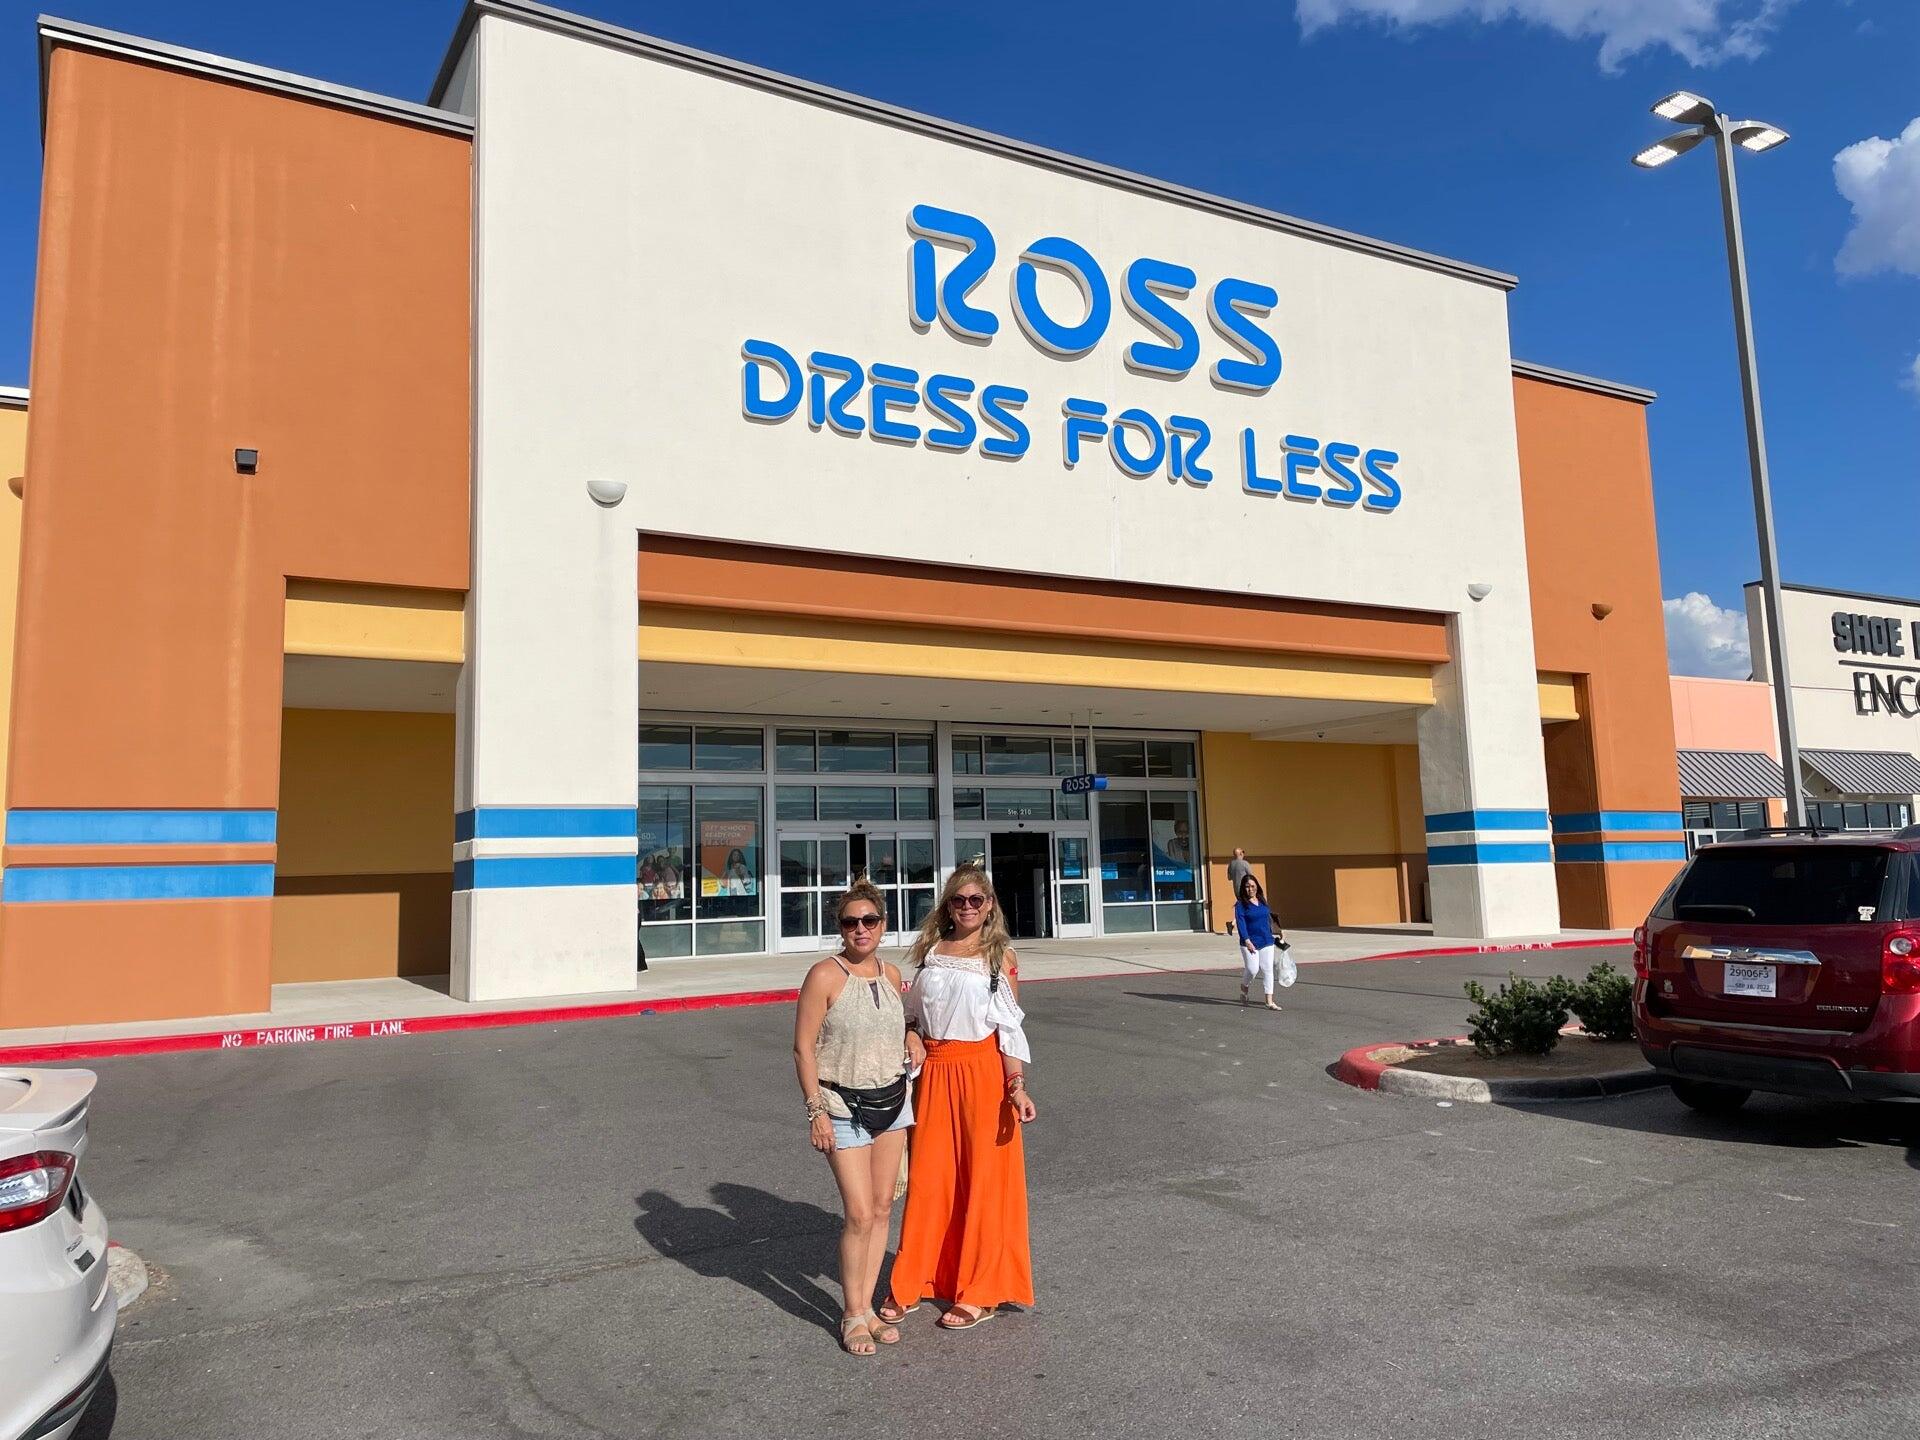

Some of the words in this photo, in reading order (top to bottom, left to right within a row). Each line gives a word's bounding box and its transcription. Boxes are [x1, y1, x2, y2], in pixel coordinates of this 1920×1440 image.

[908, 204, 1283, 392] ROSS
[742, 338, 1031, 459] DRESS
[1063, 397, 1214, 485] FOR
[1240, 427, 1402, 511] LESS
[1831, 611, 1905, 658] SHOE
[1853, 671, 1920, 719] ENC
[1065, 776, 1091, 792] ROSS
[1020, 808, 1032, 816] 210
[222, 1033, 243, 1048] NO
[256, 1027, 316, 1045] PARKING
[324, 1024, 354, 1040] FIRE
[369, 1020, 412, 1037] LANE
